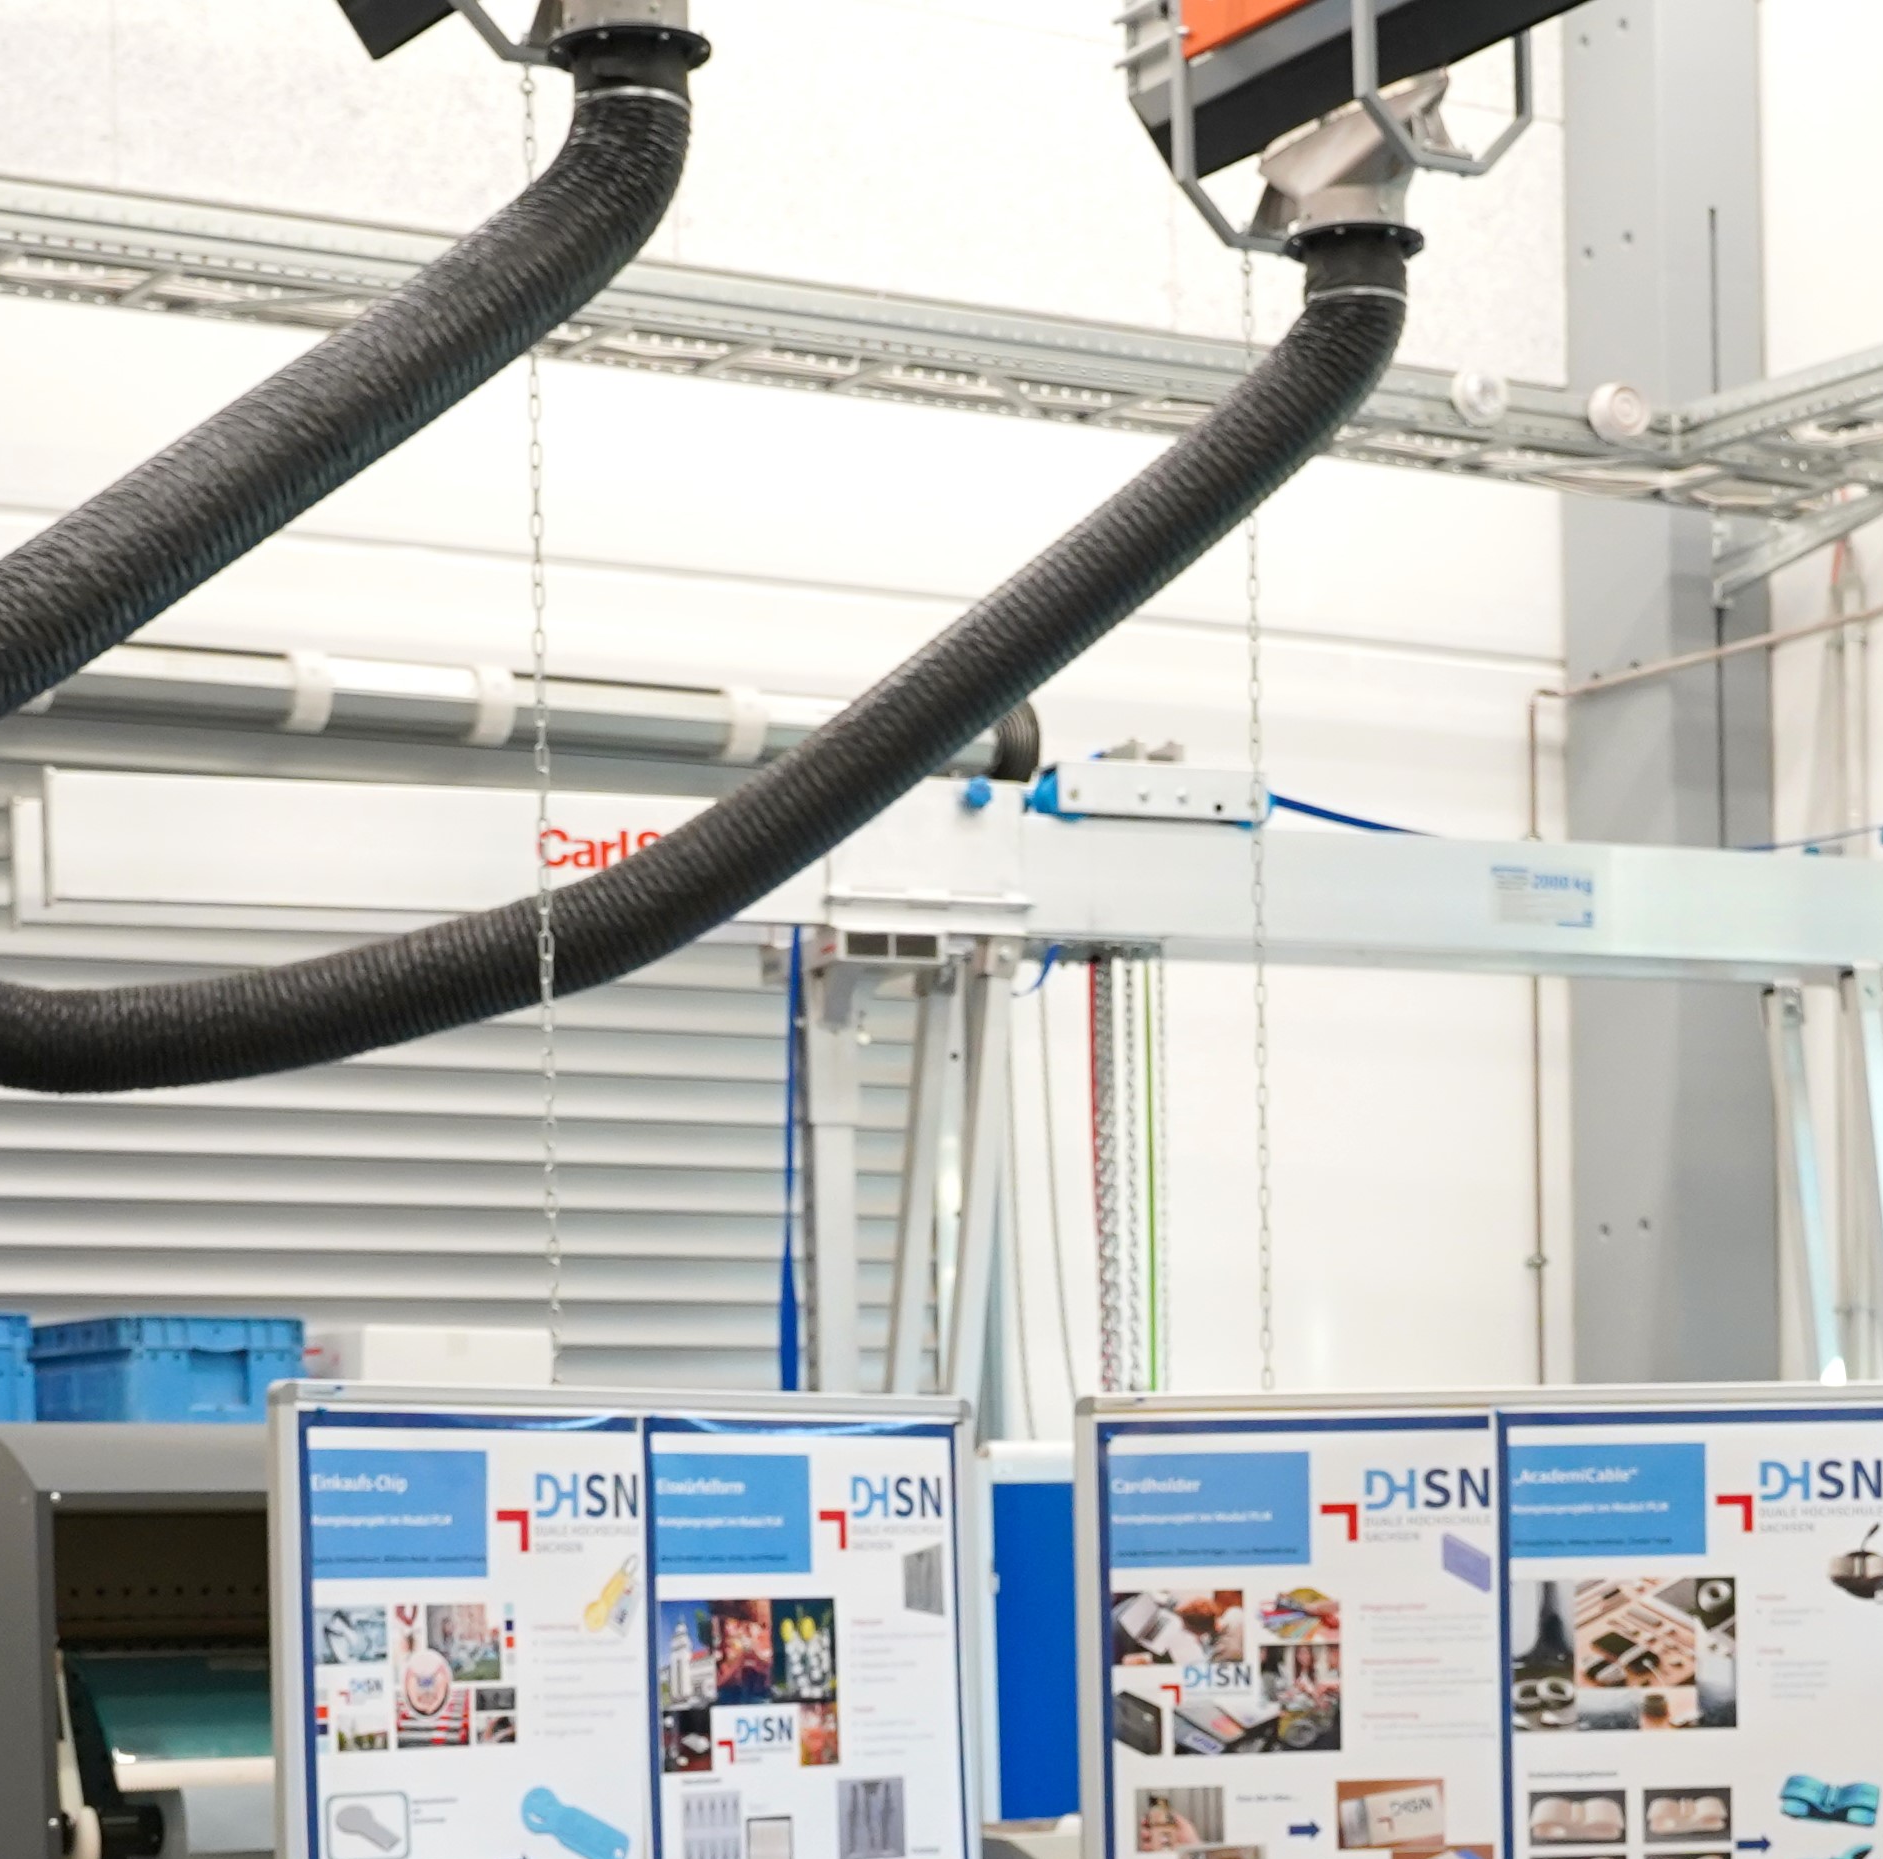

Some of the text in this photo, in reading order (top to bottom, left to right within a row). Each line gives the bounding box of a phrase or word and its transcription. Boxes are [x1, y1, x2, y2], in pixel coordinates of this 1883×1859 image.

[534, 1473, 638, 1519] DHSN
[851, 1475, 943, 1518] DHSN
[1111, 1476, 1201, 1494] Cardholder
[1364, 1468, 1491, 1511] DHSN
[1759, 1459, 1882, 1501] DHSN
[1184, 1664, 1252, 1688] DHSN
[736, 1717, 792, 1743] DHSN
